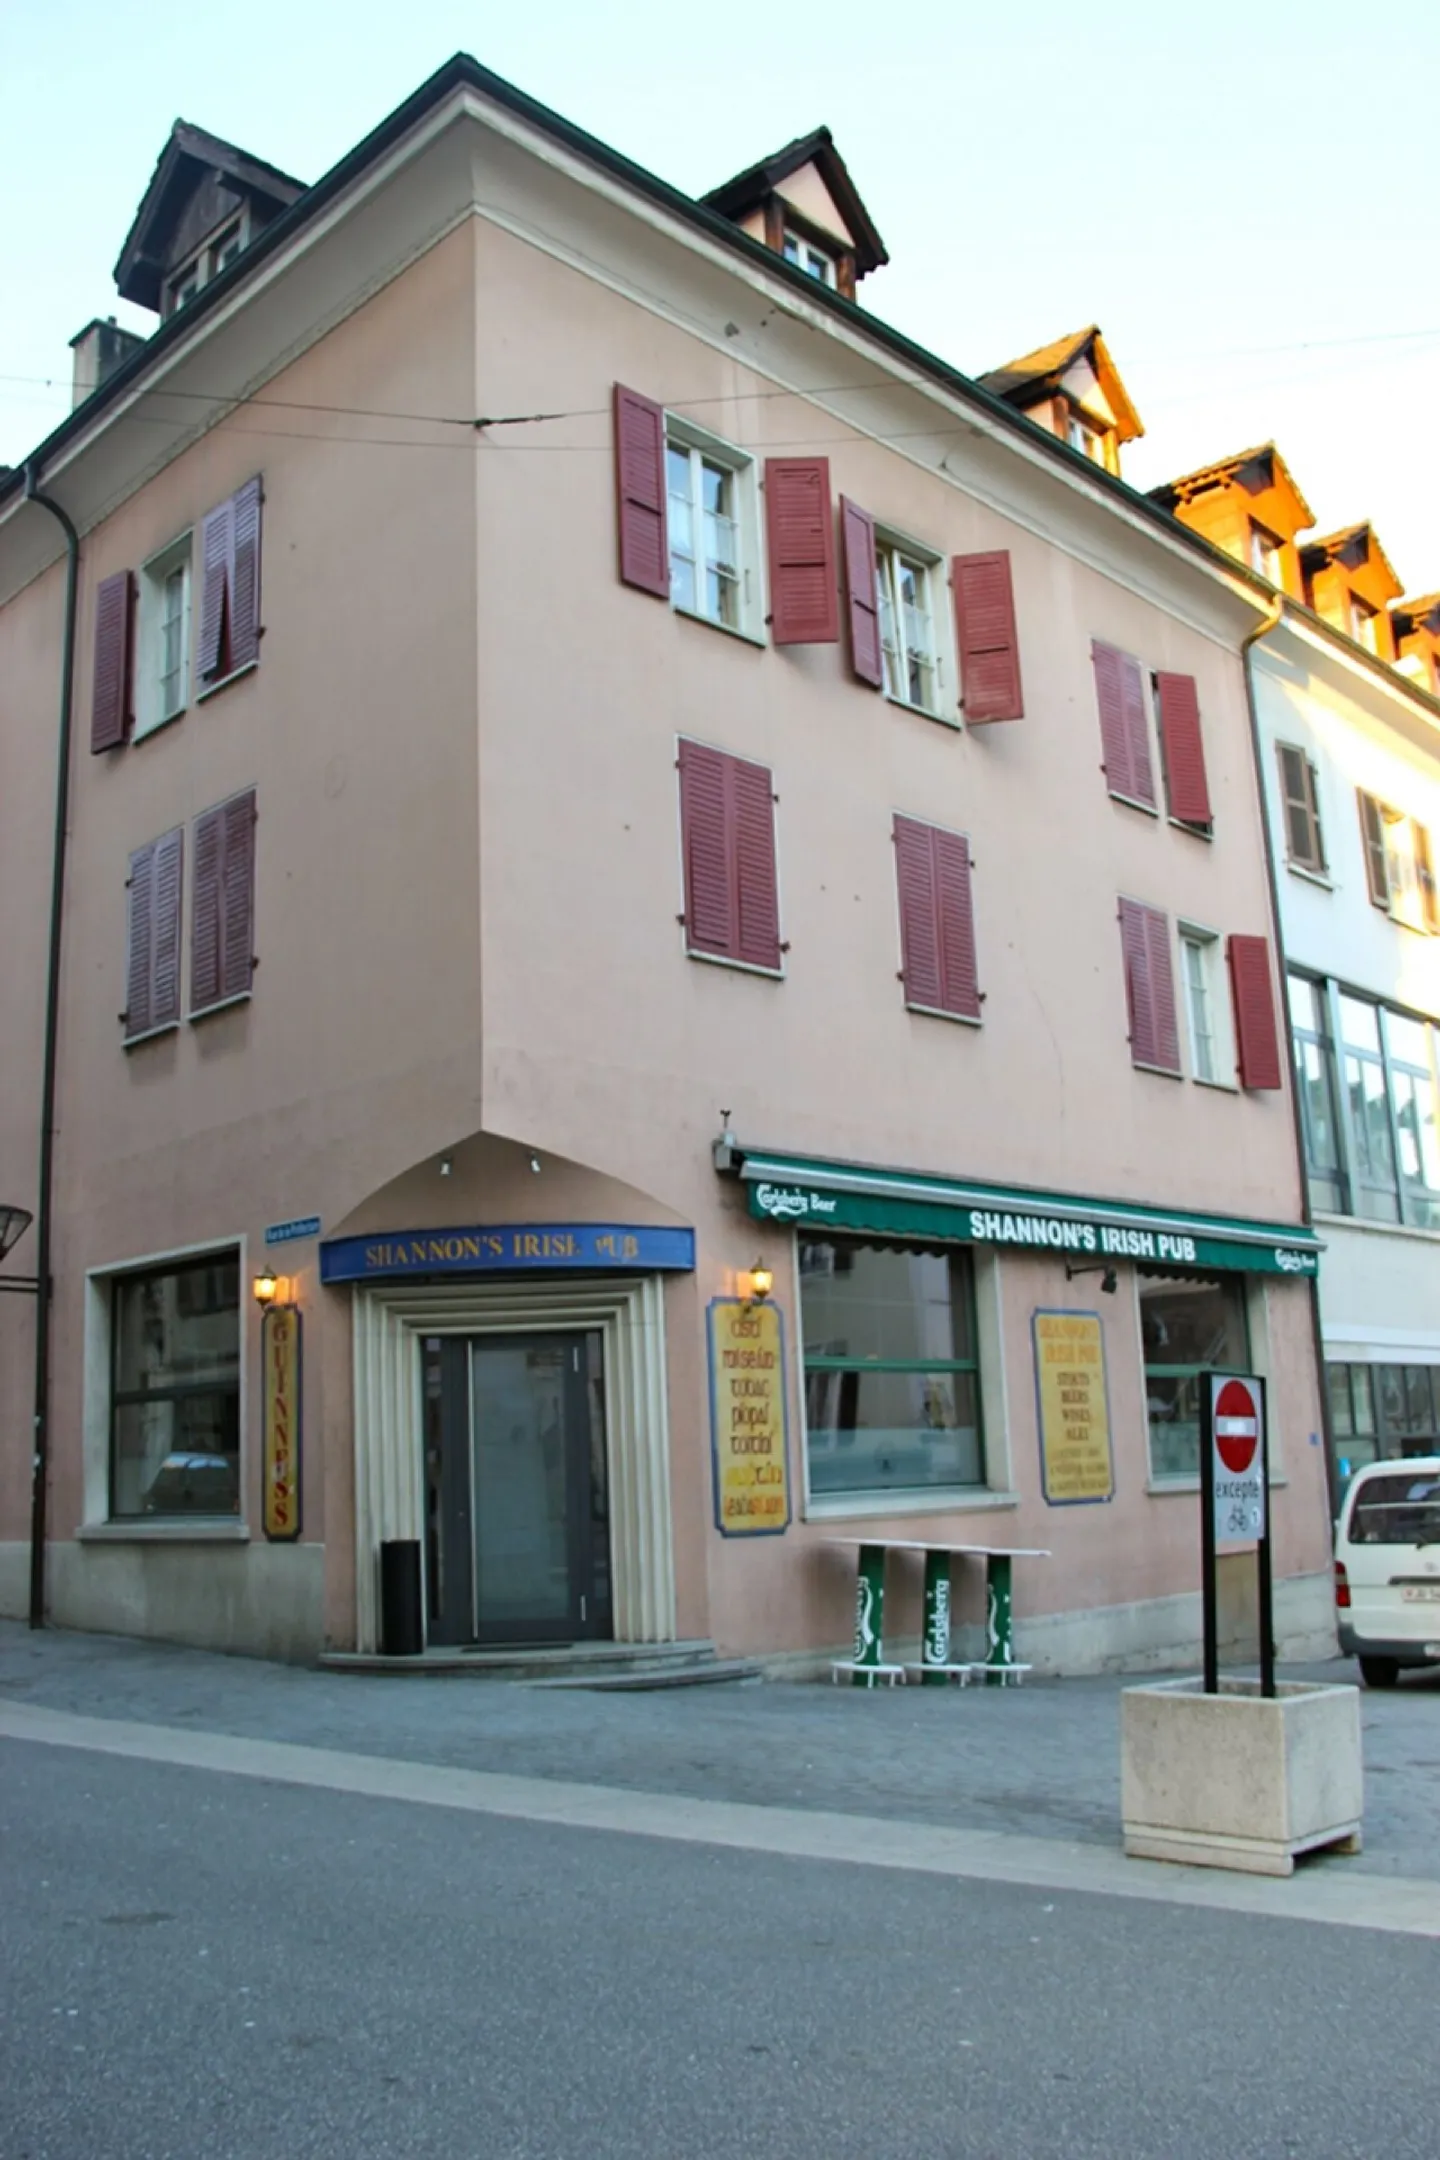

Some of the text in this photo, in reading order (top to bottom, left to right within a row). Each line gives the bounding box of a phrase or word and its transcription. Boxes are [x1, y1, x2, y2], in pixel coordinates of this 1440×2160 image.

[365, 1234, 503, 1267] SHANNON'S
[969, 1211, 1196, 1261] SHANNON'S IRISH PUB
[925, 1579, 950, 1663] Carlsberg
